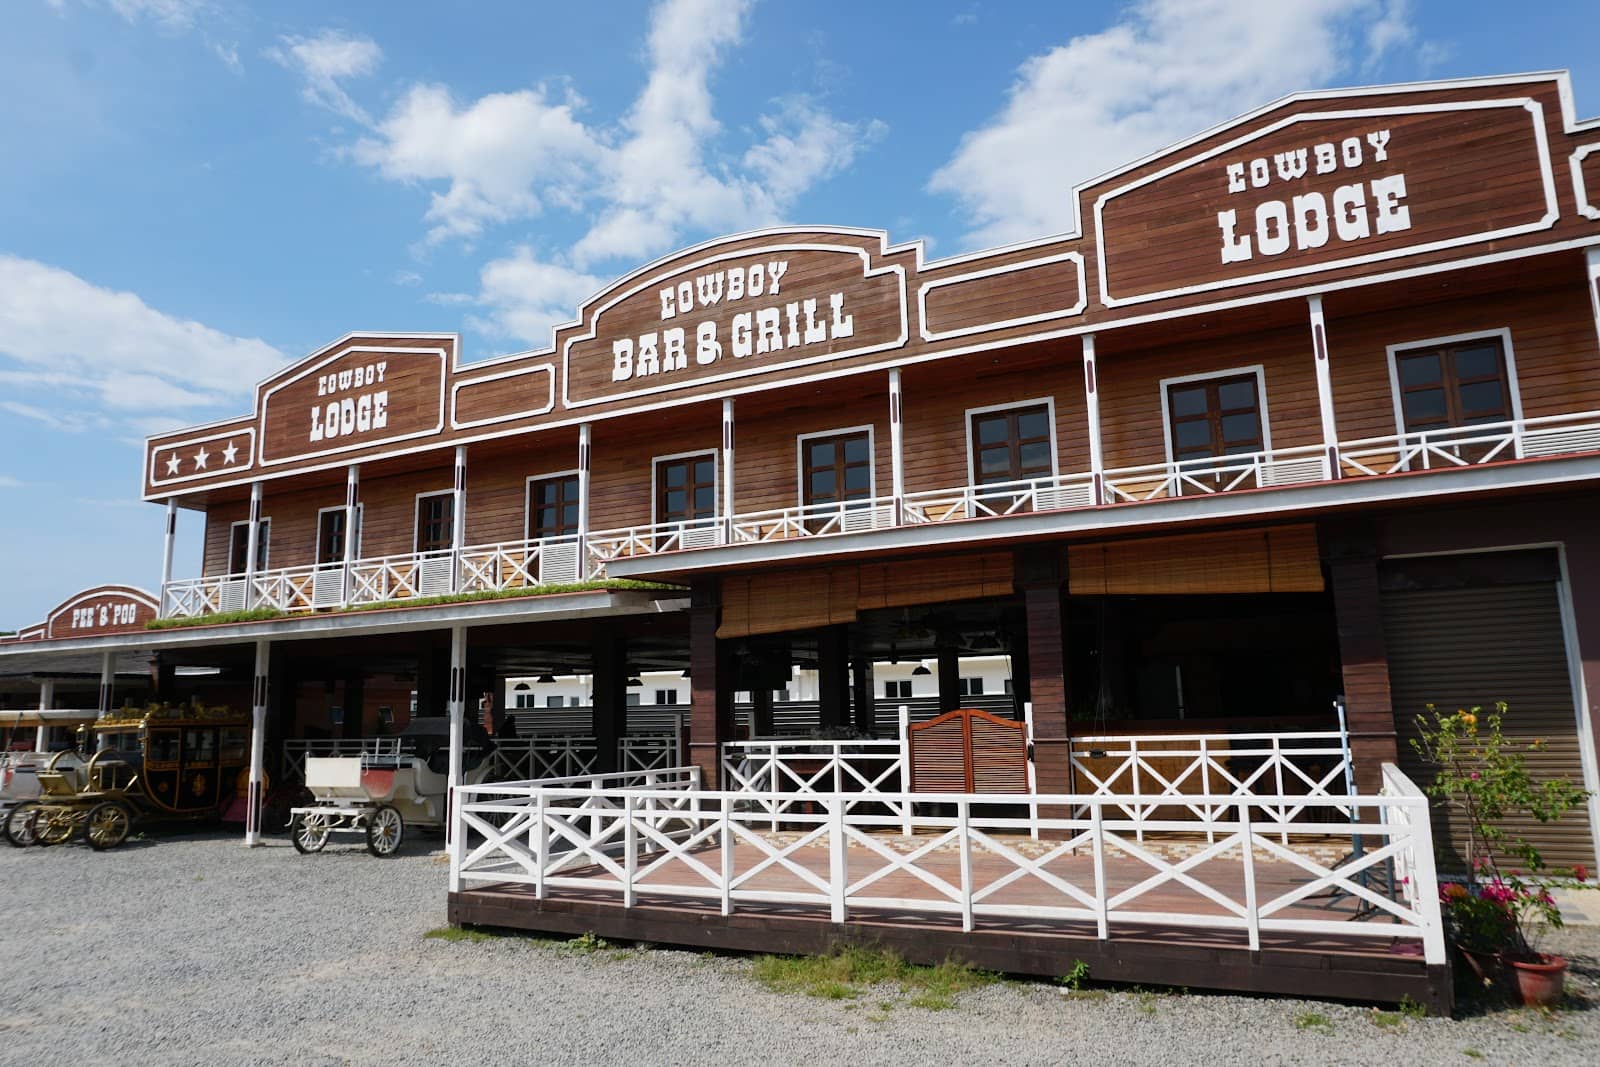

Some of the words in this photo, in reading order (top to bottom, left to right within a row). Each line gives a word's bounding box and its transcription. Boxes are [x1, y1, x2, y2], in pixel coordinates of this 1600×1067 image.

[1226, 129, 1391, 194] COWBOY
[1217, 173, 1412, 265] LODGE
[659, 260, 789, 321] COWBOY
[611, 327, 688, 382] BAR
[696, 320, 723, 365] &
[731, 292, 854, 359] GRILL
[317, 361, 387, 396] COWBOY
[309, 390, 389, 442] LODGE
